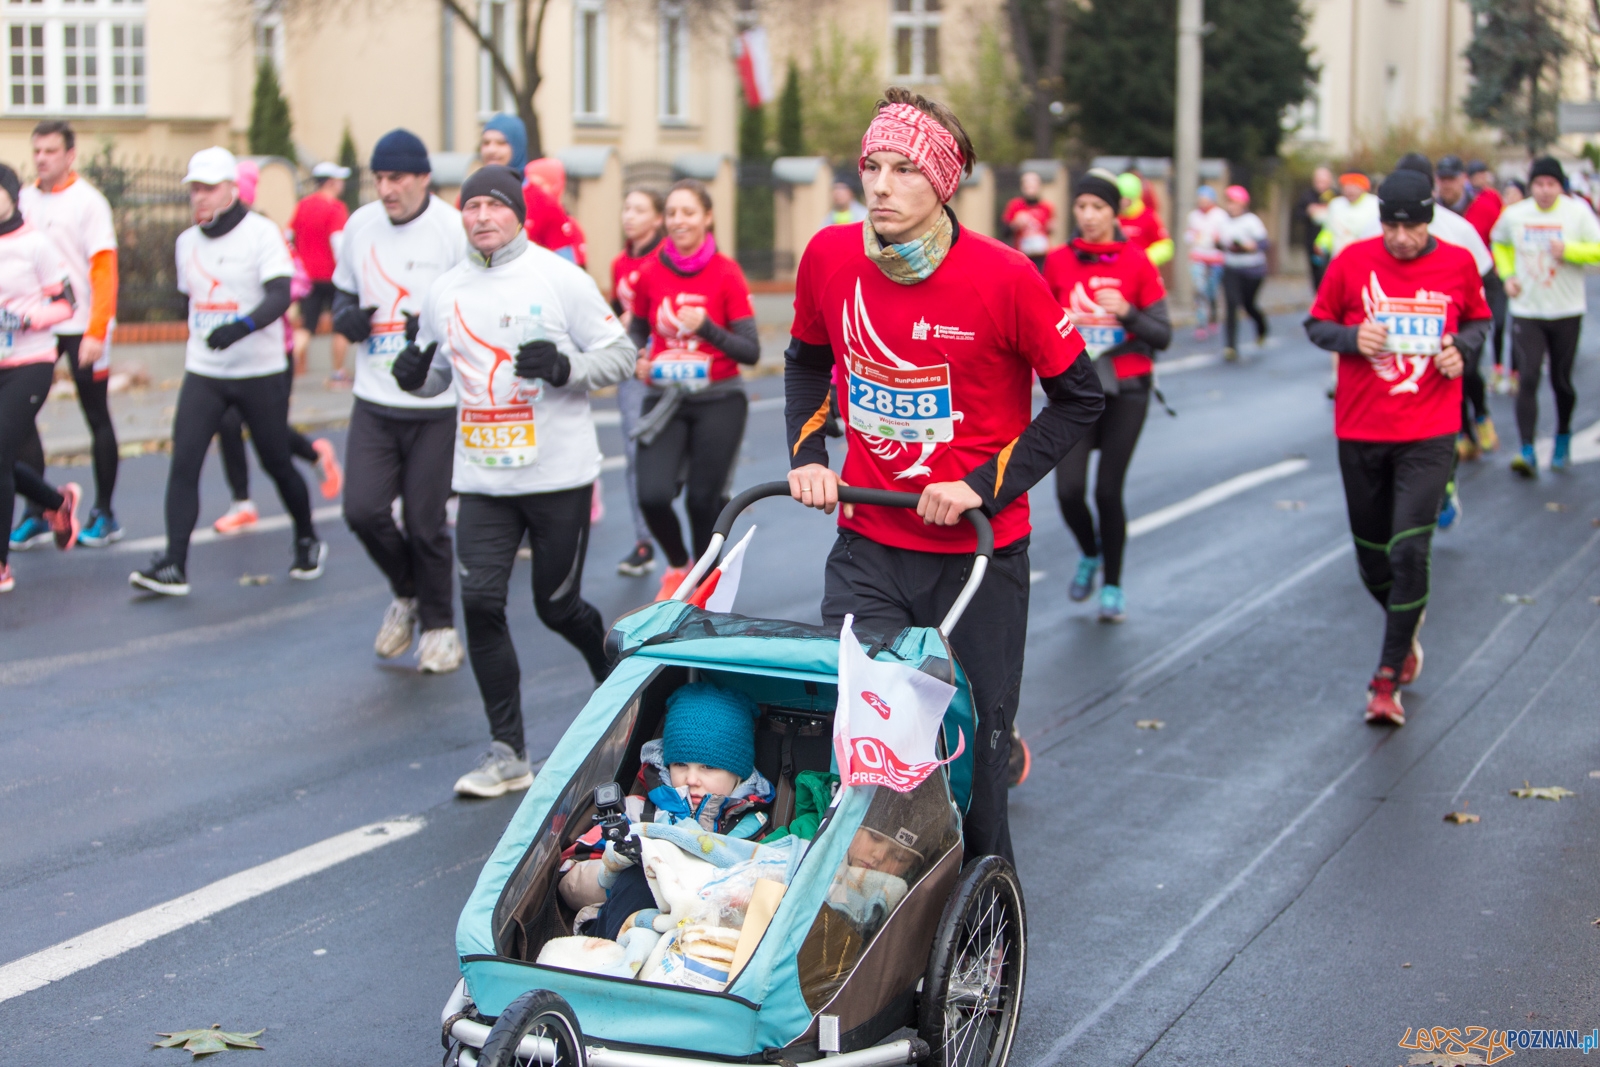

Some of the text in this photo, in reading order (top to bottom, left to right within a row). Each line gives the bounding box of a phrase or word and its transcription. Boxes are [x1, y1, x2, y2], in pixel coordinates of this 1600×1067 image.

[1386, 316, 1439, 335] 1118
[894, 375, 941, 384] RunPoland.org
[858, 383, 938, 418] 2858
[879, 416, 910, 427] Wojciech
[469, 426, 527, 448] 4352
